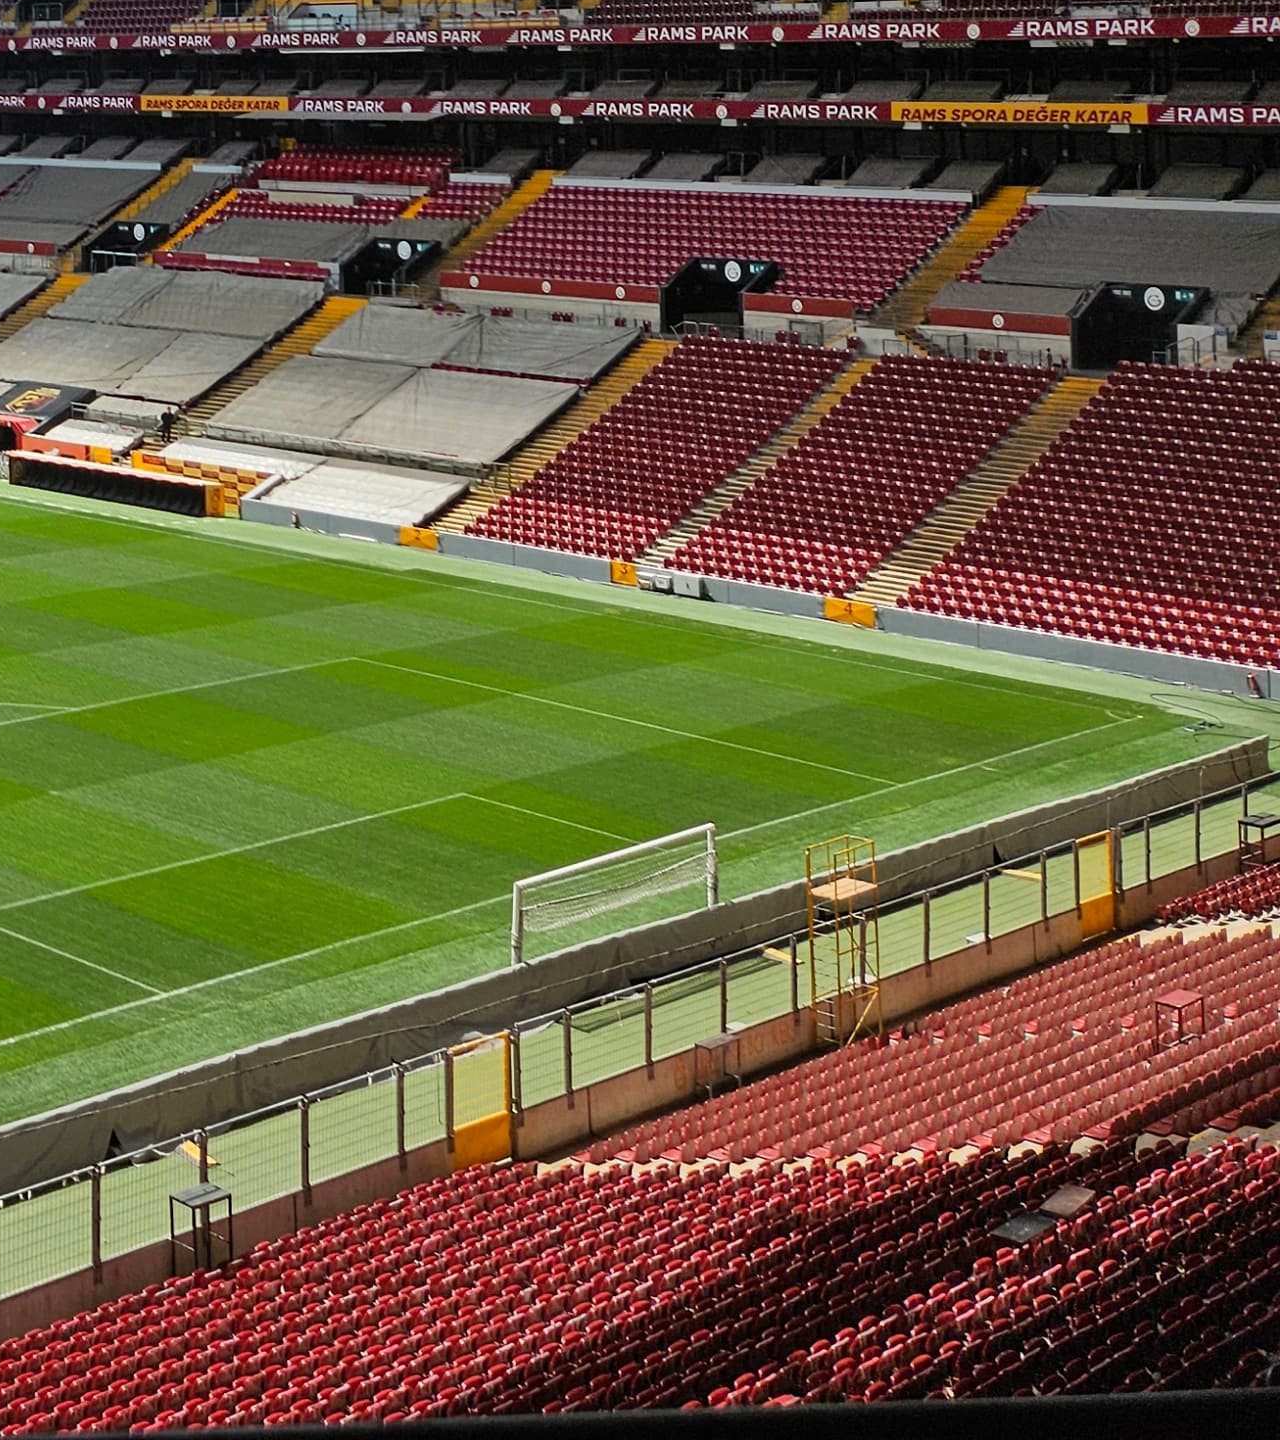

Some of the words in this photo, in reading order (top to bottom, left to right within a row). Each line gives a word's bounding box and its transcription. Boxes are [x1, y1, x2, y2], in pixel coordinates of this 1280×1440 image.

[648, 27, 696, 41] RAMS
[702, 26, 749, 40] PARK
[825, 24, 882, 39] RAMS
[886, 24, 940, 38] PARK
[1027, 21, 1088, 36] RAMS
[1096, 20, 1155, 35] PARK
[34, 37, 62, 49] RAMS
[66, 36, 96, 48] PARK
[142, 36, 174, 47] RAMS
[178, 36, 212, 47] PARK
[263, 34, 300, 46] RAMS
[304, 33, 339, 45] PARK
[396, 31, 437, 44] RAMS
[441, 30, 482, 43] PARK
[520, 30, 565, 43] RAMS
[570, 29, 613, 42] PARK
[68, 97, 100, 108] RAMS
[103, 97, 134, 109] PARK
[146, 100, 173, 109] RAMS
[176, 100, 208, 110] SPORA
[247, 100, 280, 111] KATAR
[306, 100, 343, 112] RAMS
[347, 100, 384, 112] PARK
[444, 102, 486, 115] RAMS
[490, 102, 531, 115] PARK
[596, 103, 645, 116] RAMS
[650, 104, 694, 117] PARK
[768, 104, 820, 119] RAMS
[826, 105, 878, 120] PARK
[900, 108, 947, 120] RAMS
[952, 108, 1016, 121] SPORA
[1020, 106, 1070, 122] DEĞER
[1074, 110, 1132, 122] KATAR
[1178, 108, 1246, 123] RAMS
[620, 563, 628, 575] 3
[844, 602, 853, 615] 4
